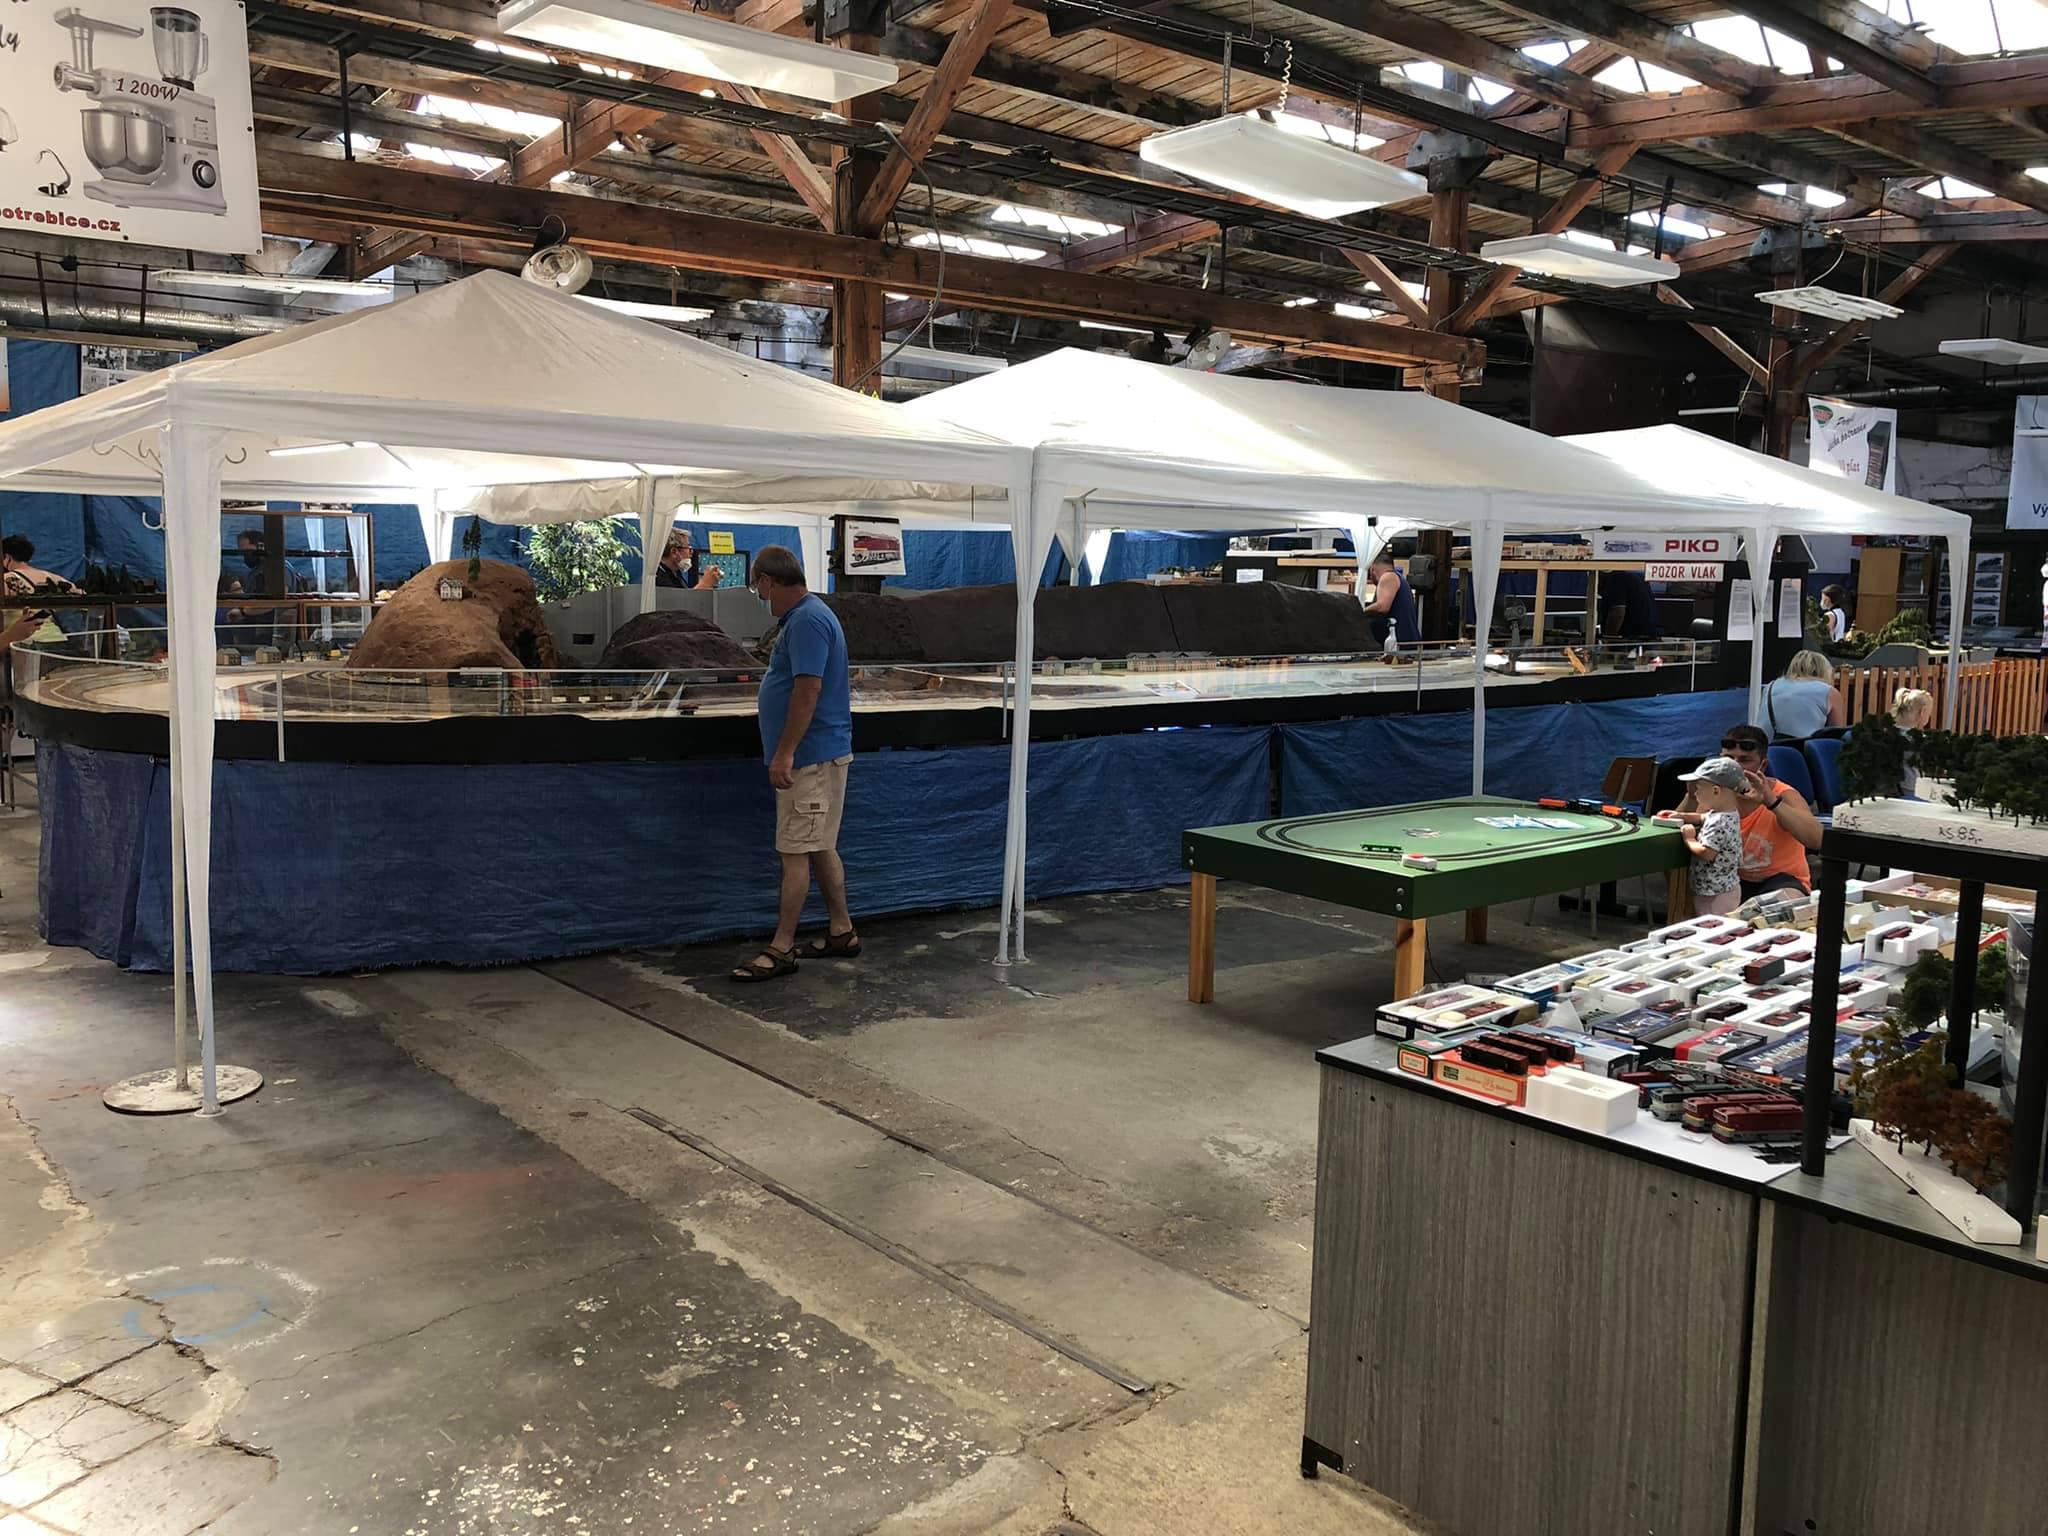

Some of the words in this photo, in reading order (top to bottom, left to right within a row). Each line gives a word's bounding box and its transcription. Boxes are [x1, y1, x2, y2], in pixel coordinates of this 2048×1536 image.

[116, 78, 125, 92] 1
[130, 83, 180, 101] 200W
[0, 205, 121, 231] otrebice.cz
[1665, 539, 1719, 553] PIKO
[1651, 565, 1685, 578] POZOR
[1691, 565, 1716, 578] VLAK
